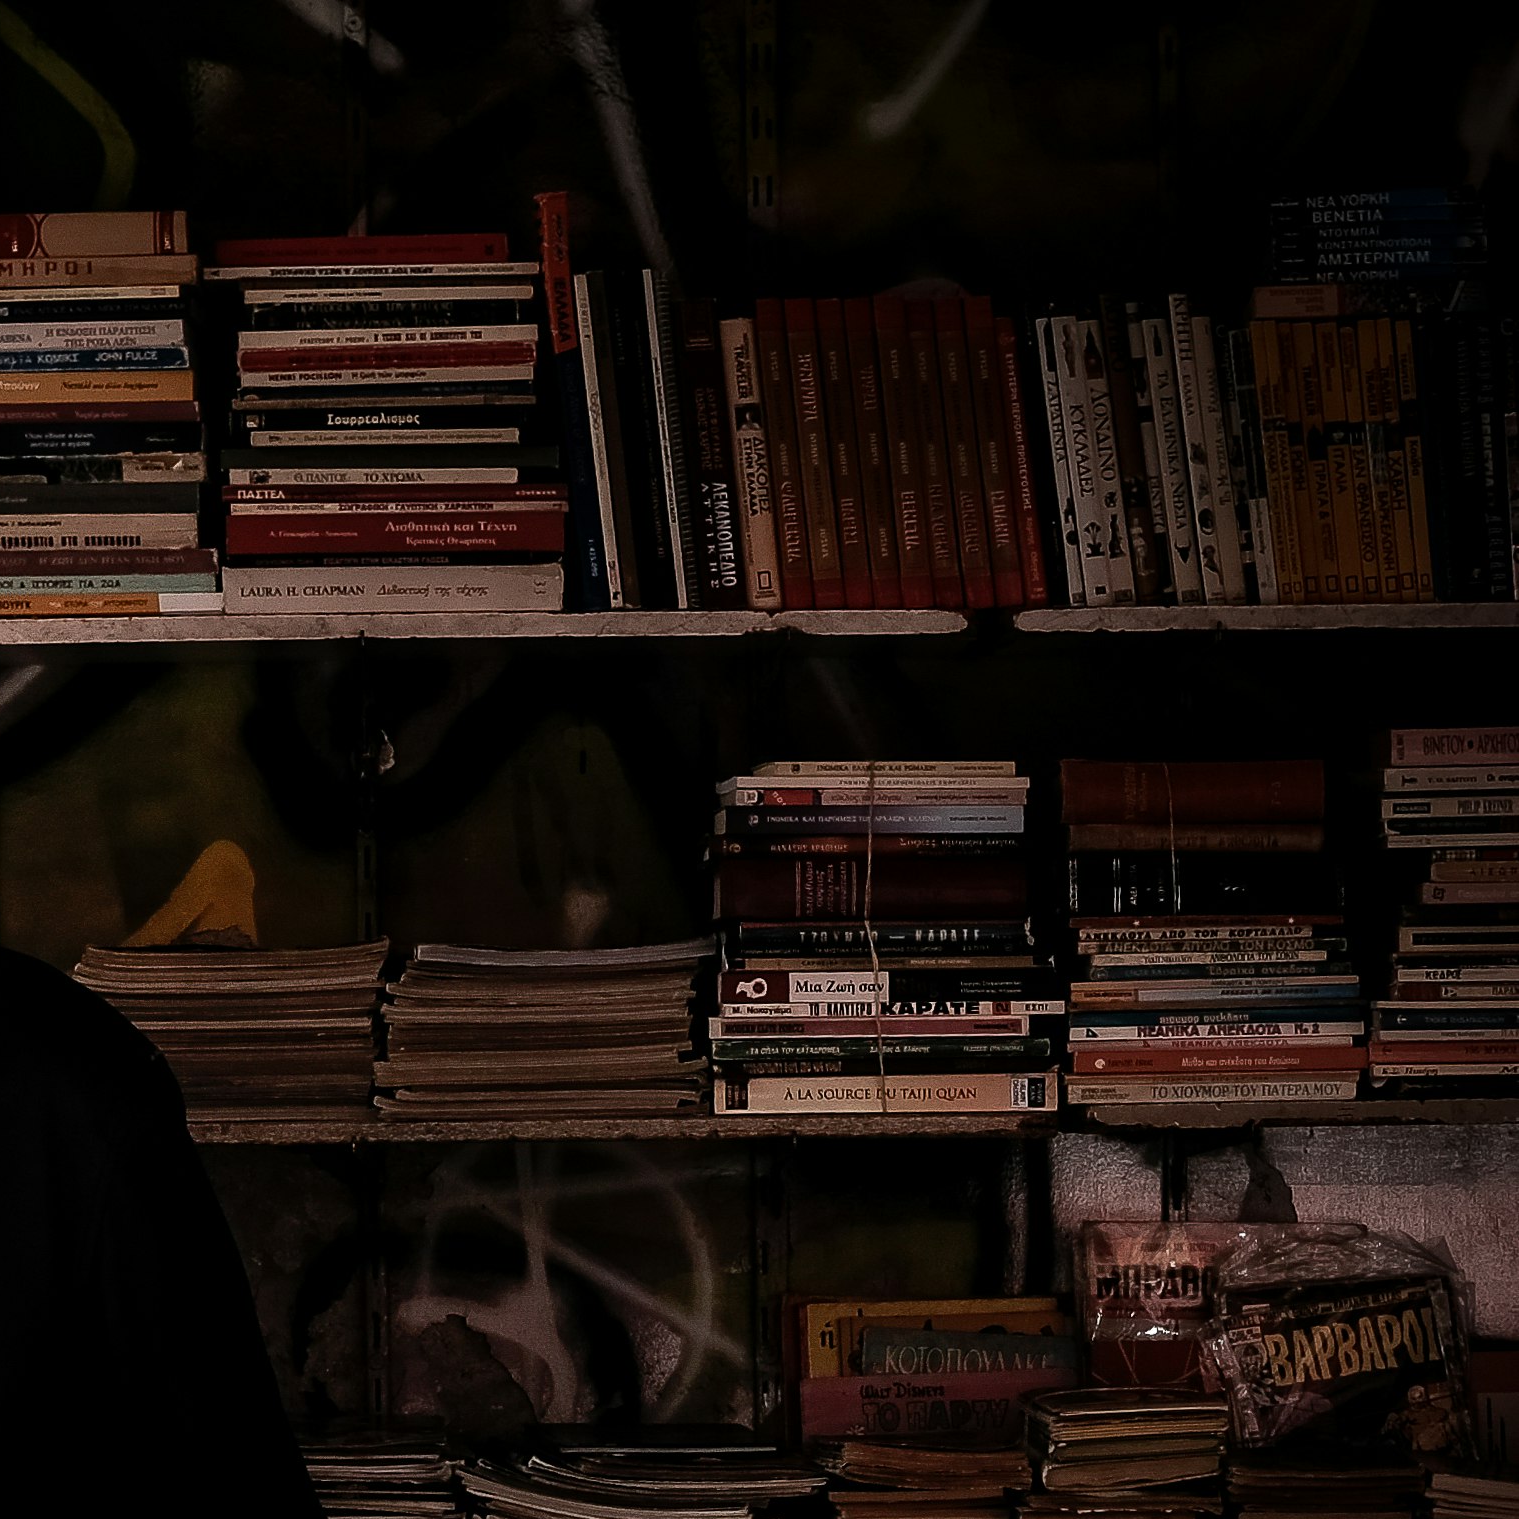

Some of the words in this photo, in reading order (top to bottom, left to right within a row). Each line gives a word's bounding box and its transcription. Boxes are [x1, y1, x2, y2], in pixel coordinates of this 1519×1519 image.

[1306, 196, 1336, 209] ΝΕΑ
[1339, 192, 1390, 208] ΥΟΡΚΗ
[1312, 209, 1385, 224] ΒΕΝΕΤΙΑ
[1317, 251, 1431, 267] ΑΜΣΤΕΡΝΤΑΜ
[1349, 269, 1400, 281] ΥΟΡΚΗ
[1172, 298, 1192, 362] ΚΡΗΤΗ
[95, 351, 123, 362] JOHN
[733, 345, 749, 400] TRAVELER
[1090, 388, 1116, 482] ΛΟΝΔΙΝΟ
[743, 436, 754, 470] ΣΤΗΝ
[1069, 404, 1094, 498] ΚΥΚΛΑΔΕΣ
[1159, 396, 1179, 475] ΕΛΛΗΝΙΚΑ
[1169, 482, 1188, 530] ΝΗΣΙΑ
[1353, 448, 1367, 478] ΣΑΝ
[753, 436, 771, 515] ΔΙΑΚΟΠΕΣ
[1291, 450, 1306, 491] ΡΩΜΗ
[1314, 462, 1327, 507] ΠΡΑΓΑ
[1333, 448, 1347, 494] ΙΤΑΛΙΑ
[1390, 456, 1406, 511] ΧΑΒΑΗ
[237, 489, 286, 499] ΠΑΣΤΕΛ
[747, 472, 759, 517] ΕΛΛΑΔΑ
[453, 522, 474, 532] και
[901, 491, 920, 550] ΒΕΝΕΤΙΑ
[1319, 511, 1329, 520] &
[1357, 482, 1374, 562] ΦΡΑΝΣΙΣΚΟ
[711, 482, 737, 588] ΛΕΚΑΝΟΠΕΔΙΟ
[1378, 491, 1395, 572] ΒΑΡΚΕΛΩΝΗ
[240, 586, 282, 597] LAURA
[287, 586, 300, 596] H.
[303, 585, 365, 596] CHAPMAN
[1423, 735, 1465, 755] ΒΙΝΕΤΟΥ
[1084, 930, 1151, 941] ΑΝΕΚΔΟΤΑ
[1160, 929, 1185, 939] ΑΠΟ
[1194, 928, 1219, 938] ΤΟΝ
[1105, 942, 1174, 953] ΑΝΕΚΔΟΤΑ
[1239, 941, 1264, 951] ΤΟΝ
[1267, 939, 1315, 950] ΚΟΣΜΟ
[794, 980, 822, 993] Μια
[826, 980, 856, 995] Ζωή
[809, 1003, 820, 1017] ΤΟ
[881, 1001, 980, 1015] ΚΑΡΑΤΕ
[1025, 1003, 1049, 1012] ΕΣΠΙ
[1136, 1026, 1200, 1037] ΝΕΑΝΙΚΑ
[1207, 1024, 1282, 1036] ΑΝΕΚΔΟΤΑ
[1311, 1024, 1320, 1034] 2
[798, 1088, 812, 1100] LA
[814, 1087, 871, 1101] SOURCE
[903, 1087, 932, 1100] TAIJI
[935, 1087, 977, 1101] QUAN
[1151, 1088, 1170, 1099] ΤΟ
[1173, 1086, 1229, 1099] ΧΙΟΥΜΟΡ
[1234, 1086, 1258, 1098] ΤΟΥ
[1261, 1084, 1311, 1097] ΠΑΤΕΡΑ
[1313, 1084, 1342, 1096] ΜΟΥ
[1262, 1305, 1443, 1388] ΒΑΡΒΑΡΟΙ
[861, 1402, 900, 1432] ΤΟ
[906, 1399, 1009, 1429] ΠΑΡΤΥ
